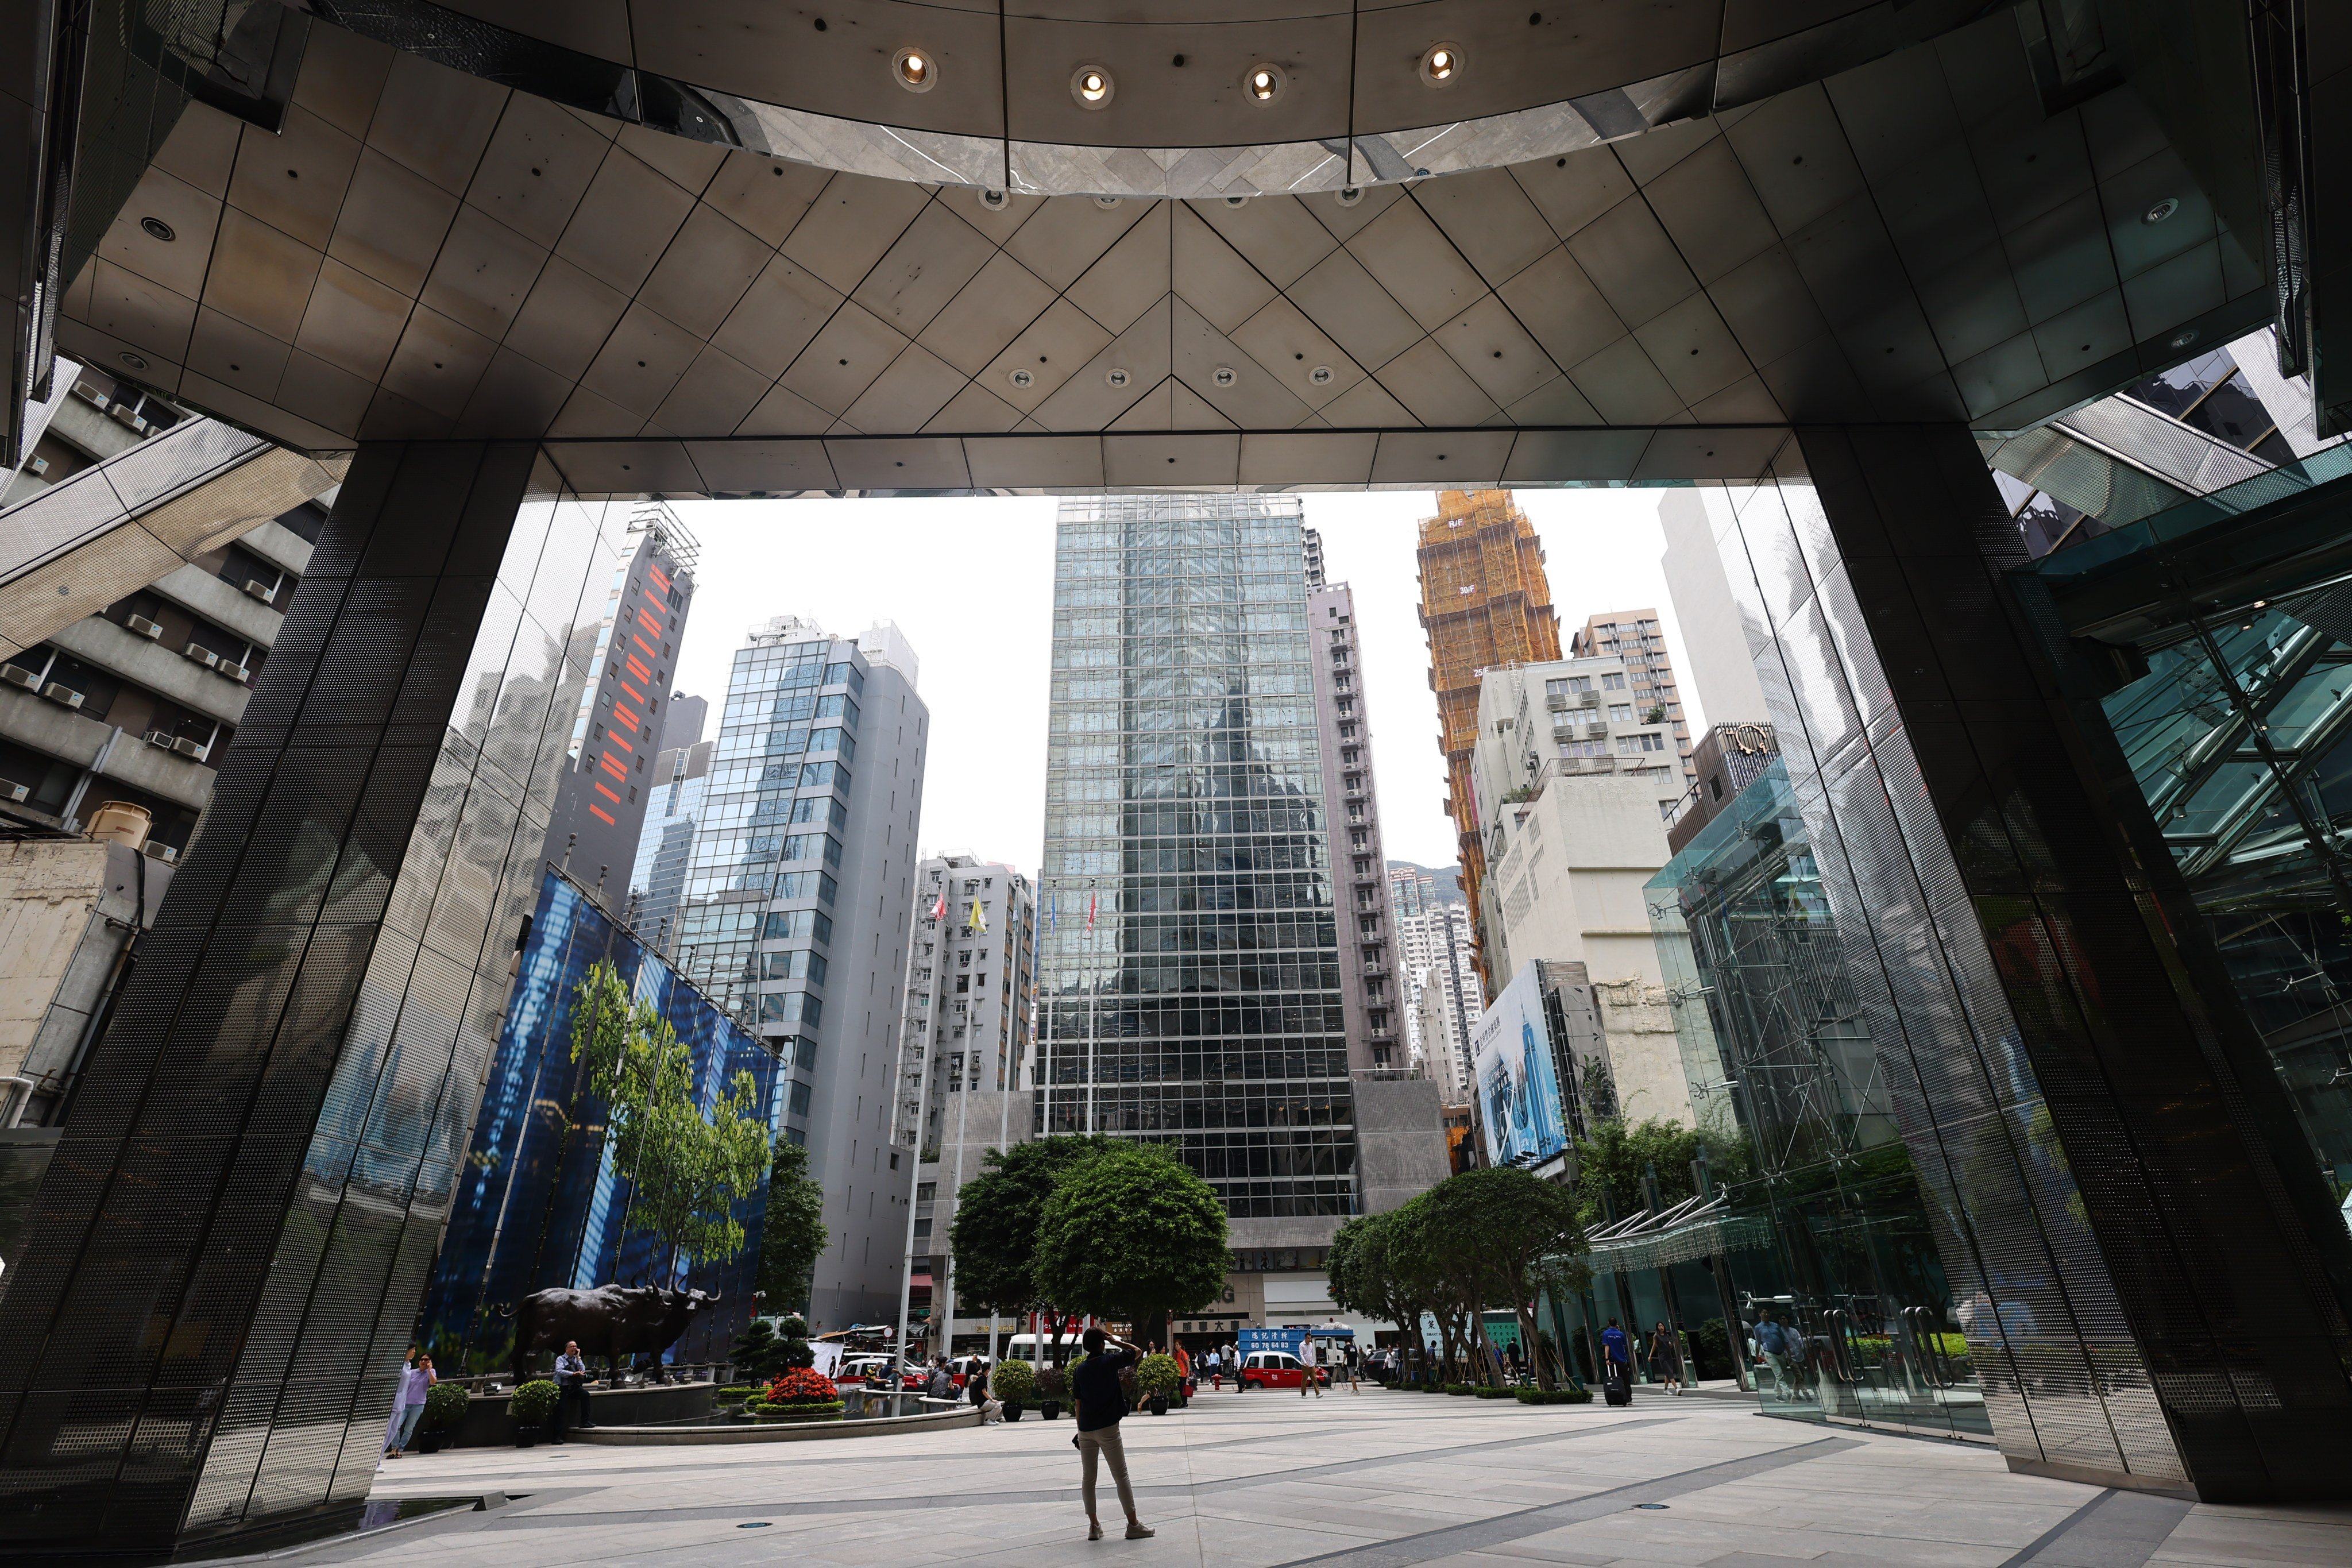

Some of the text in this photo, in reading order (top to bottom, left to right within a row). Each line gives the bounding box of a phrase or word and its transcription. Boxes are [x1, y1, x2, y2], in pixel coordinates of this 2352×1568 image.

[1449, 519, 1462, 528] R/F
[1459, 585, 1474, 594] 30/F
[1474, 667, 1489, 677] 25/F
